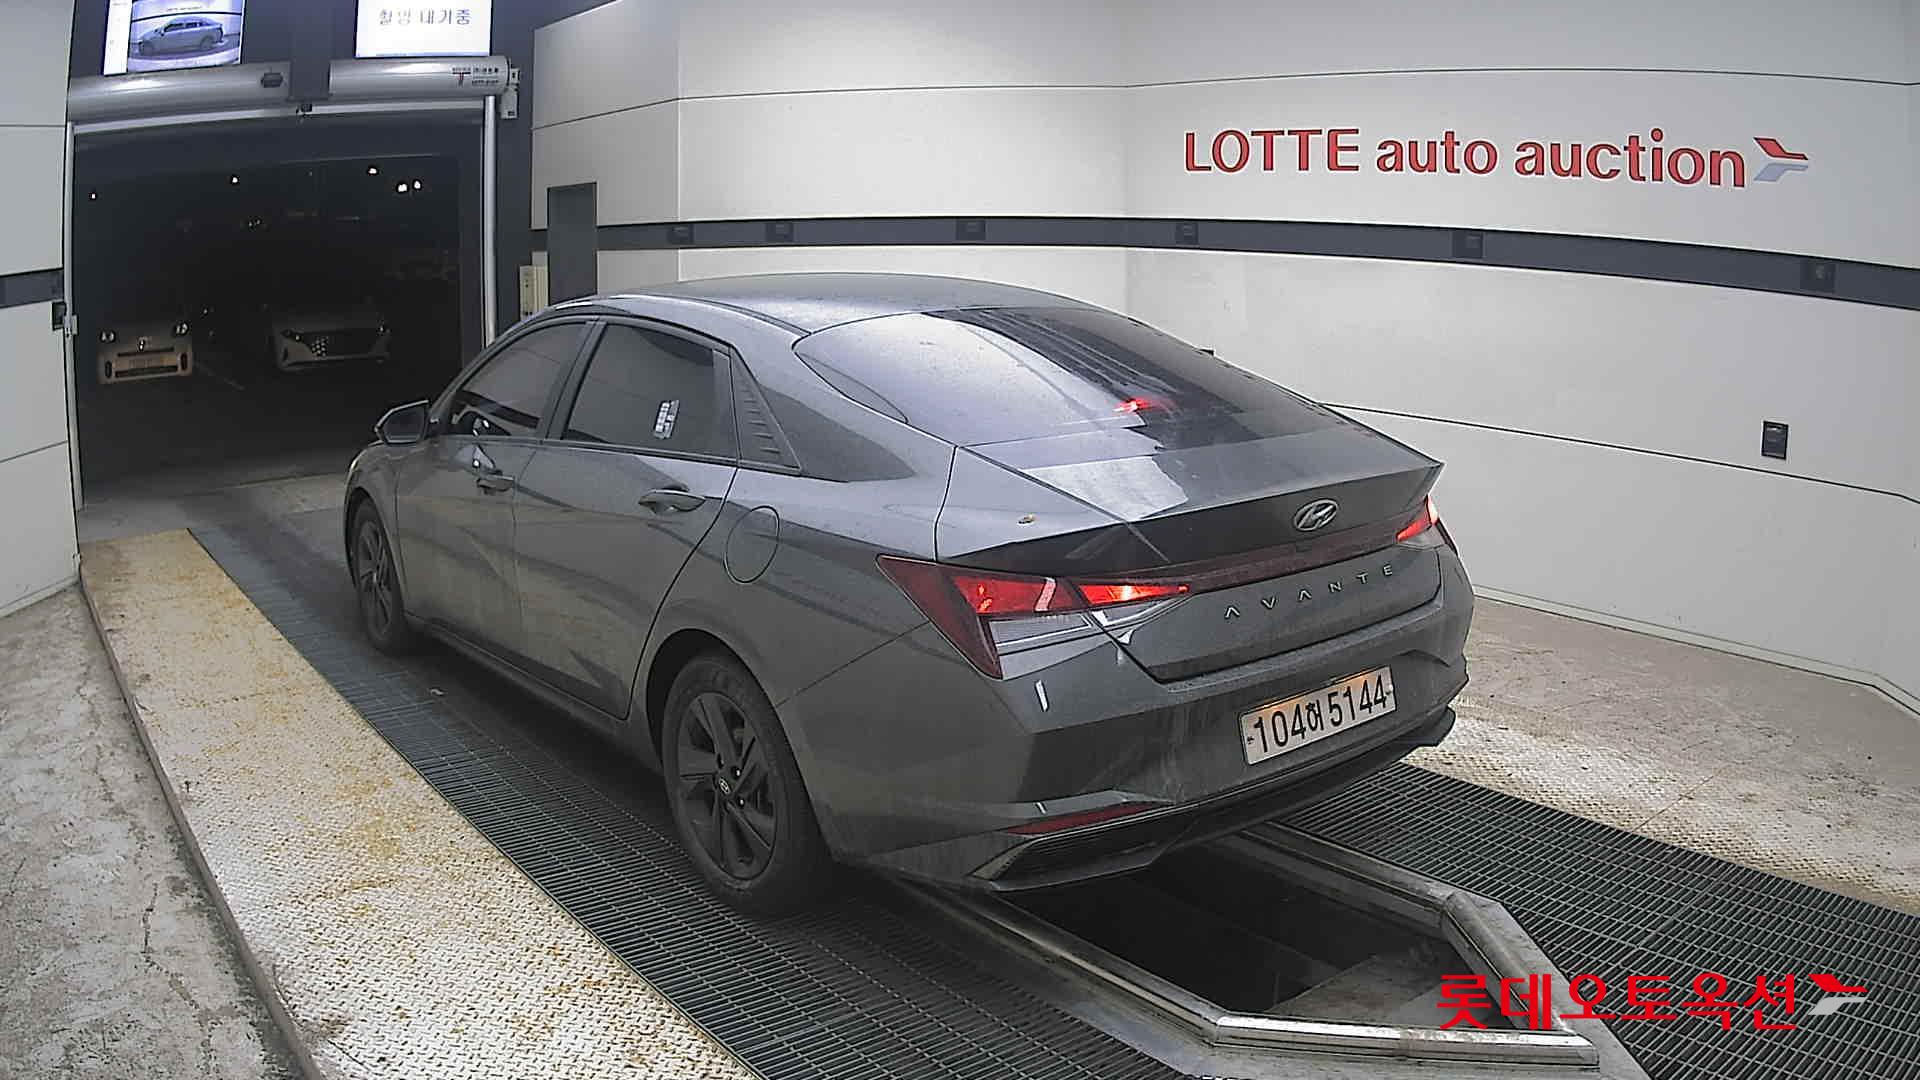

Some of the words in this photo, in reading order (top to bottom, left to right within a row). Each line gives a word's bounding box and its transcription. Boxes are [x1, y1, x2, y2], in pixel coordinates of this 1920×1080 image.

[1185, 128, 1360, 173] LOTTE
[1376, 130, 1498, 174] auto
[1514, 128, 1745, 188] auction
[1224, 564, 1393, 619] AVANTE
